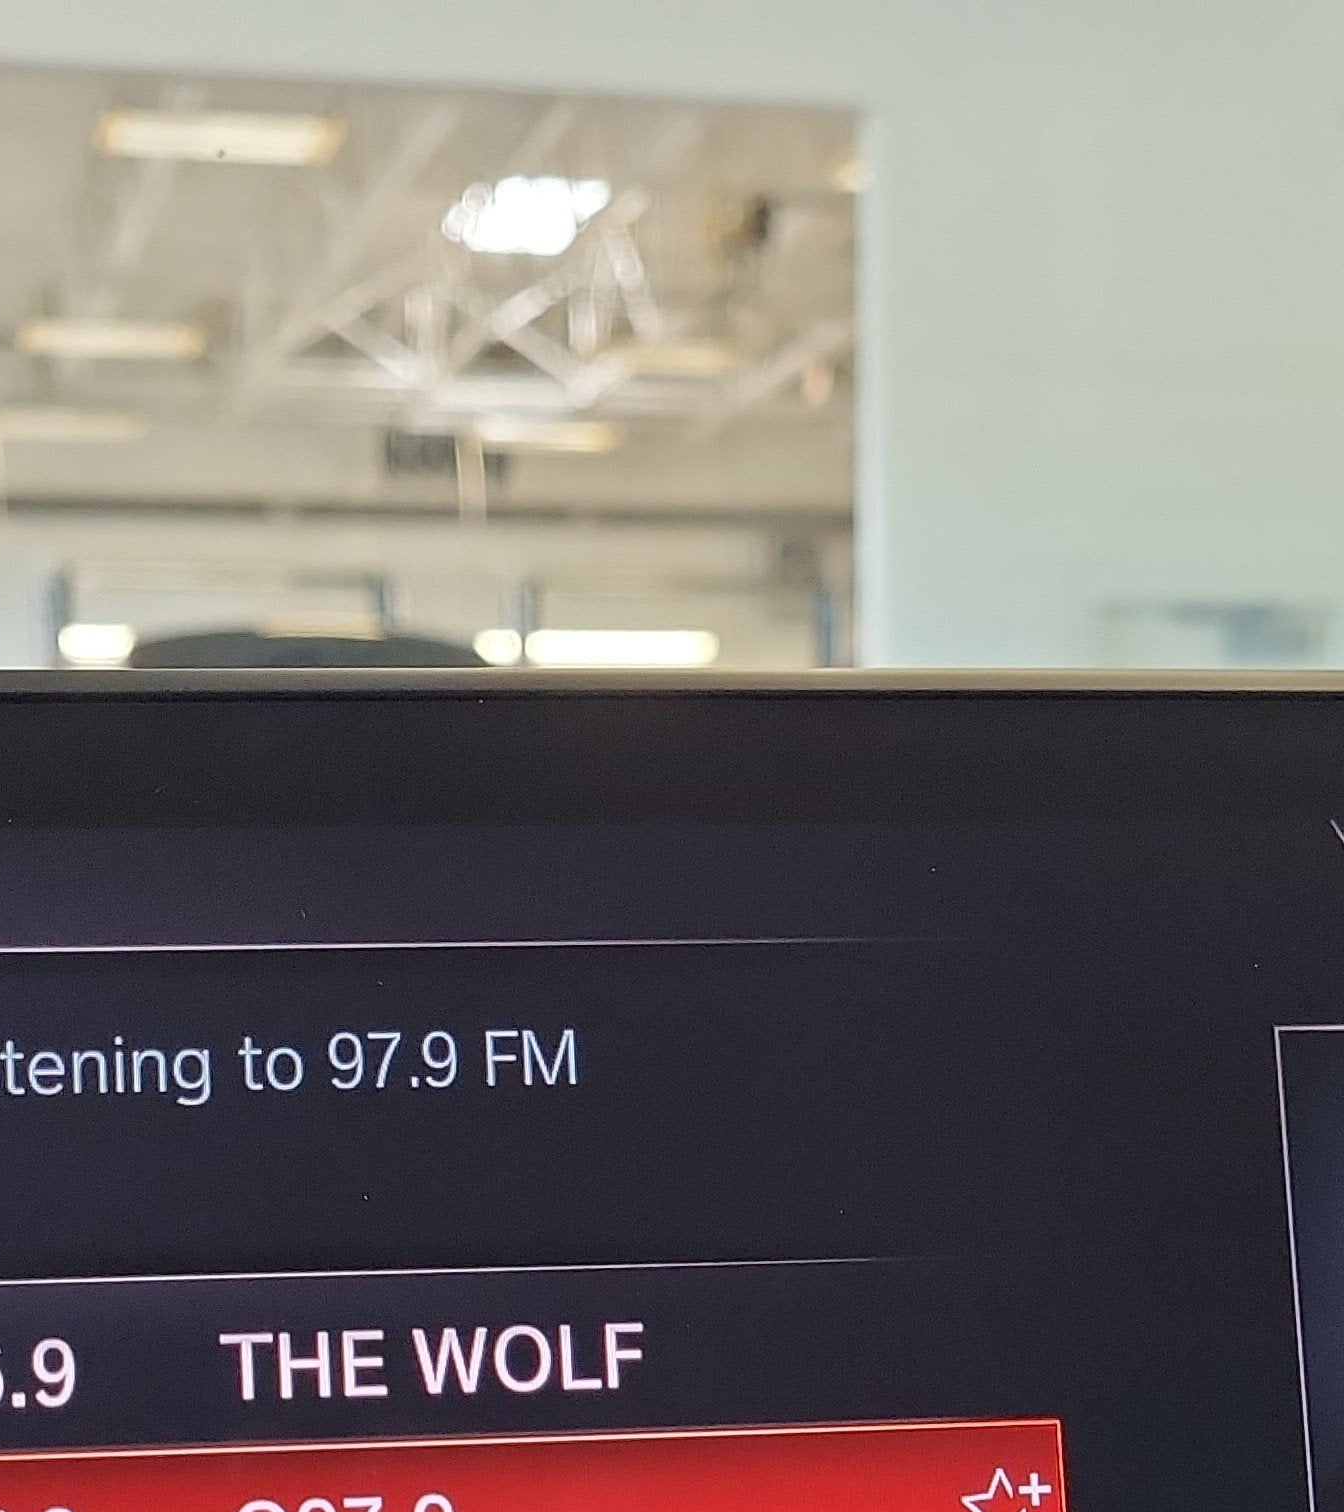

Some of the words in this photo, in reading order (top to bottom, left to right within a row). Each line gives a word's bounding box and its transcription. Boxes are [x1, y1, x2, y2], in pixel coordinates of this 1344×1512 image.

[236, 1035, 305, 1095] to
[327, 1029, 459, 1091] 97.9
[483, 1027, 578, 1088] FM
[218, 1328, 390, 1402] THE
[410, 1321, 645, 1396] WOLF
